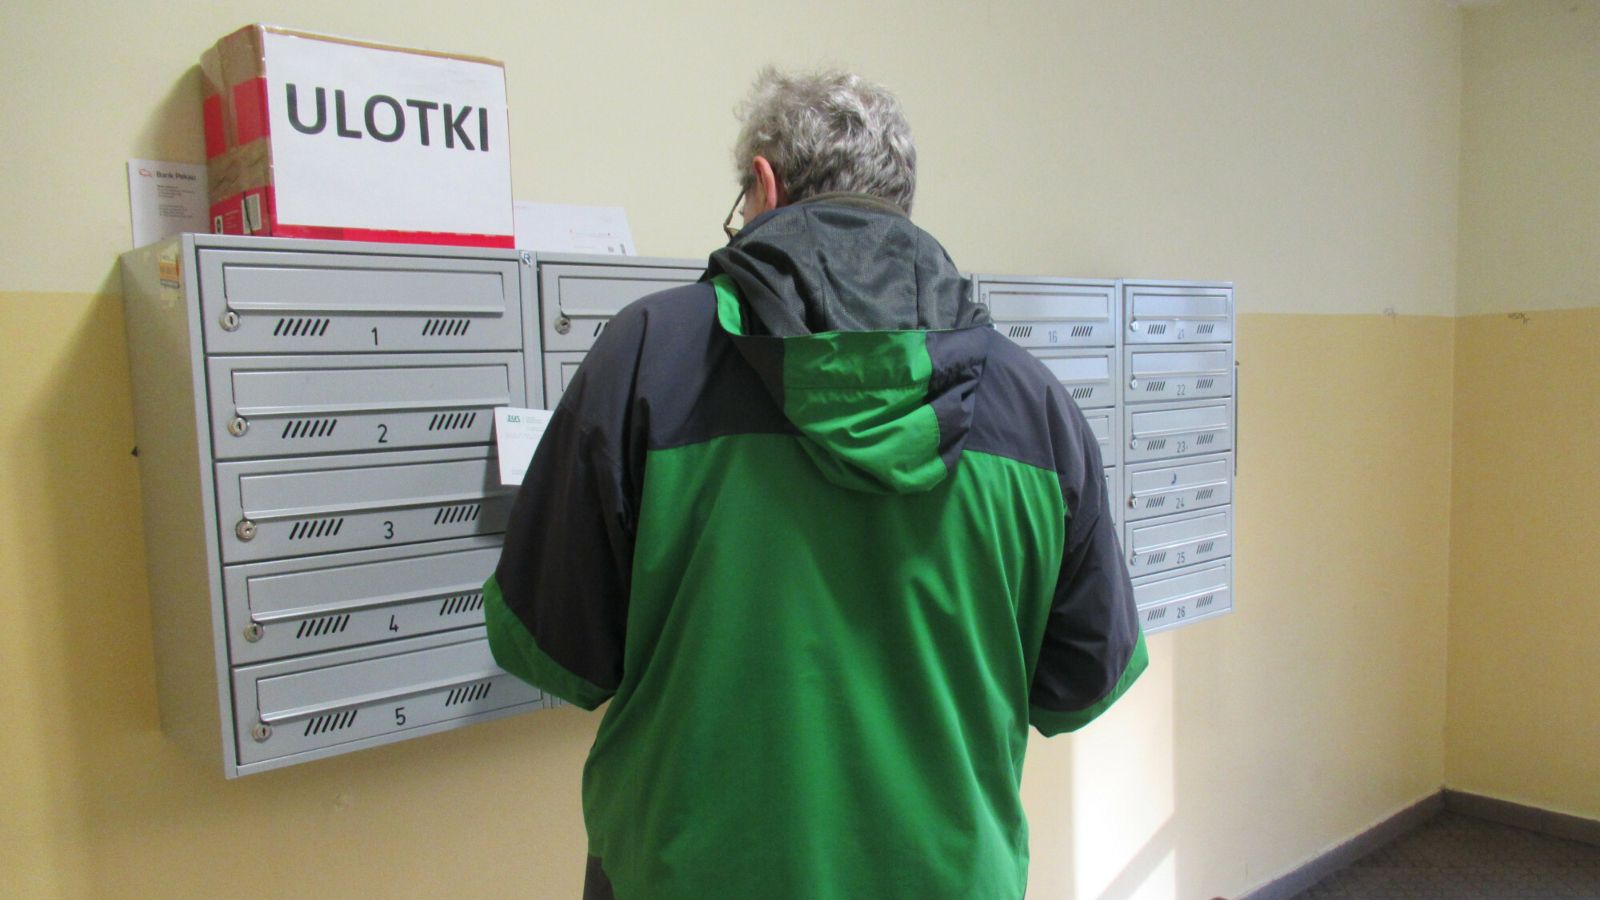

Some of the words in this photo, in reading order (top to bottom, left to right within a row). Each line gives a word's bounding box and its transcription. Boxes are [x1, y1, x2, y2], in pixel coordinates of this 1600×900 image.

[285, 83, 489, 151] ULOTKI
[371, 327, 378, 346] 1
[1048, 330, 1058, 344] 16
[1176, 384, 1186, 396] 22
[377, 424, 388, 444] 2
[1176, 440, 1186, 453] 23
[1176, 497, 1185, 509] 24
[384, 521, 395, 541] 3
[1176, 552, 1186, 564] 25
[1176, 606, 1186, 619] 26
[388, 614, 399, 633] 4
[395, 707, 406, 727] 5
